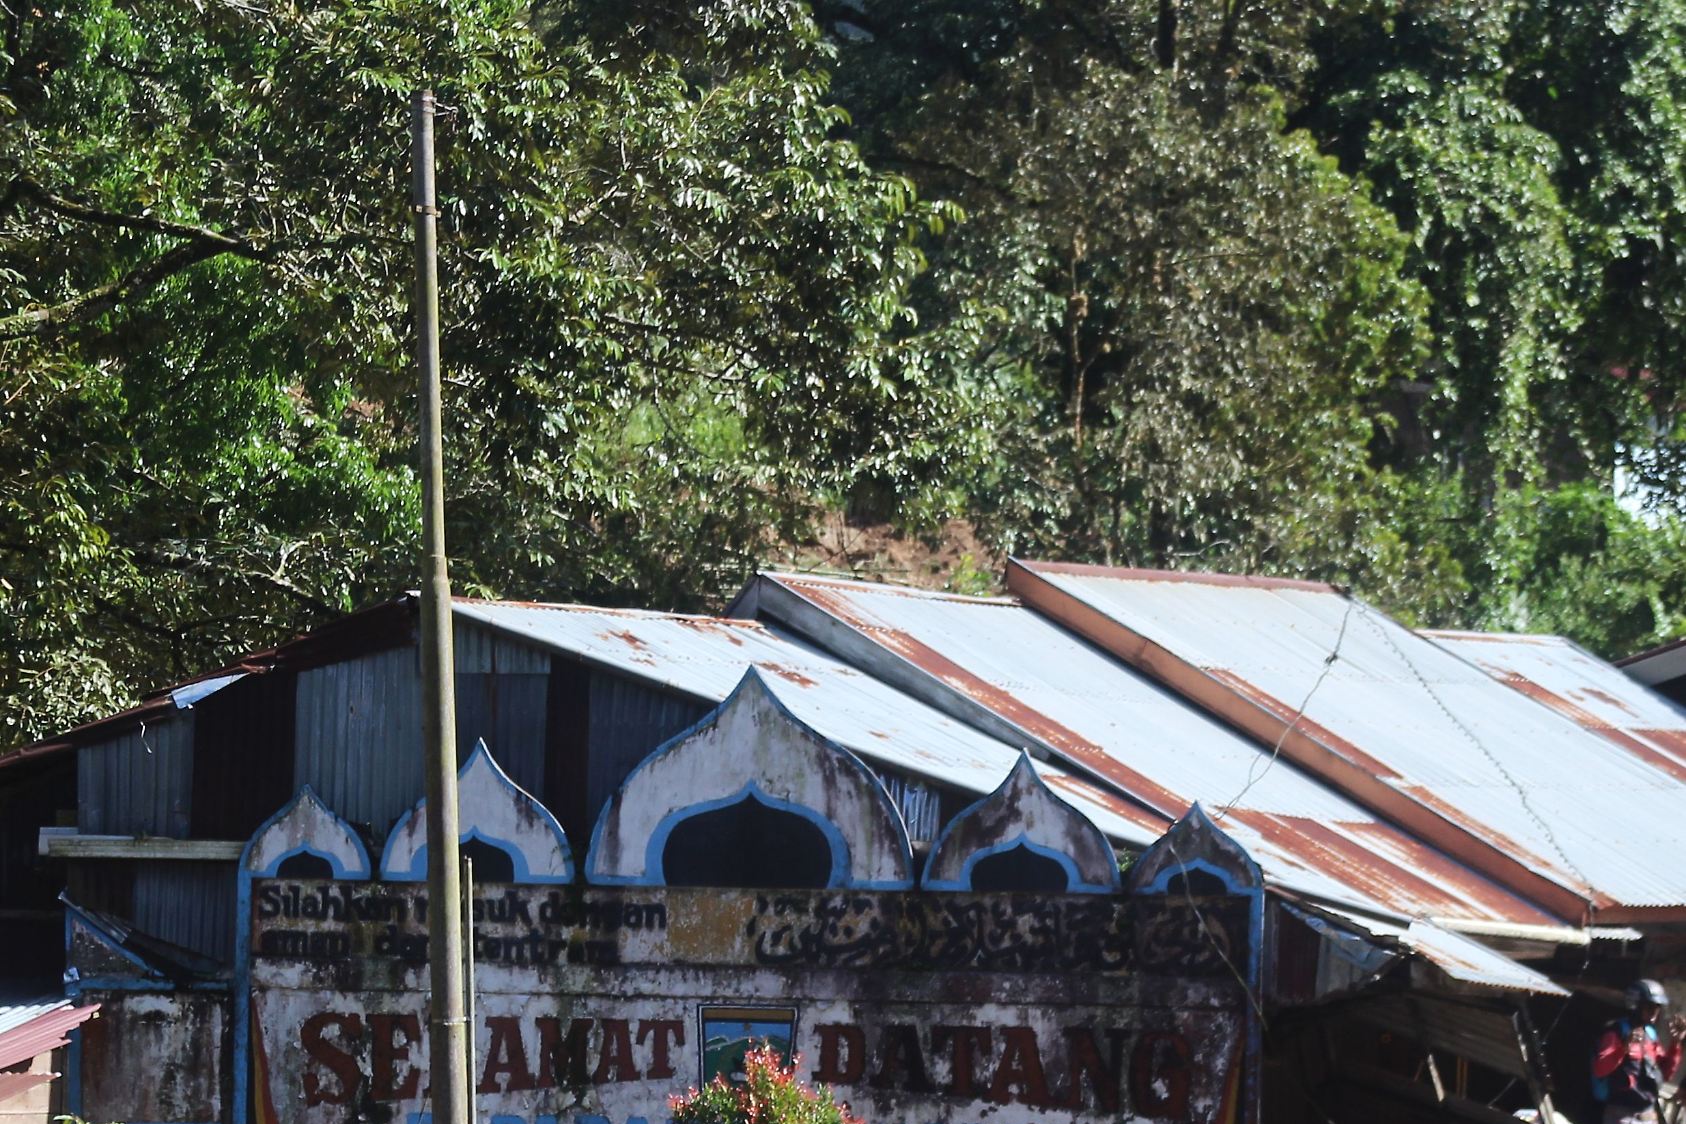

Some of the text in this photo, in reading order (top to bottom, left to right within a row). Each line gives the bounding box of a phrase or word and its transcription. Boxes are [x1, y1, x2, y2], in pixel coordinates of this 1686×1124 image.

[413, 889, 531, 926] suk
[301, 1012, 1194, 1119] SEAMAT DATANG
